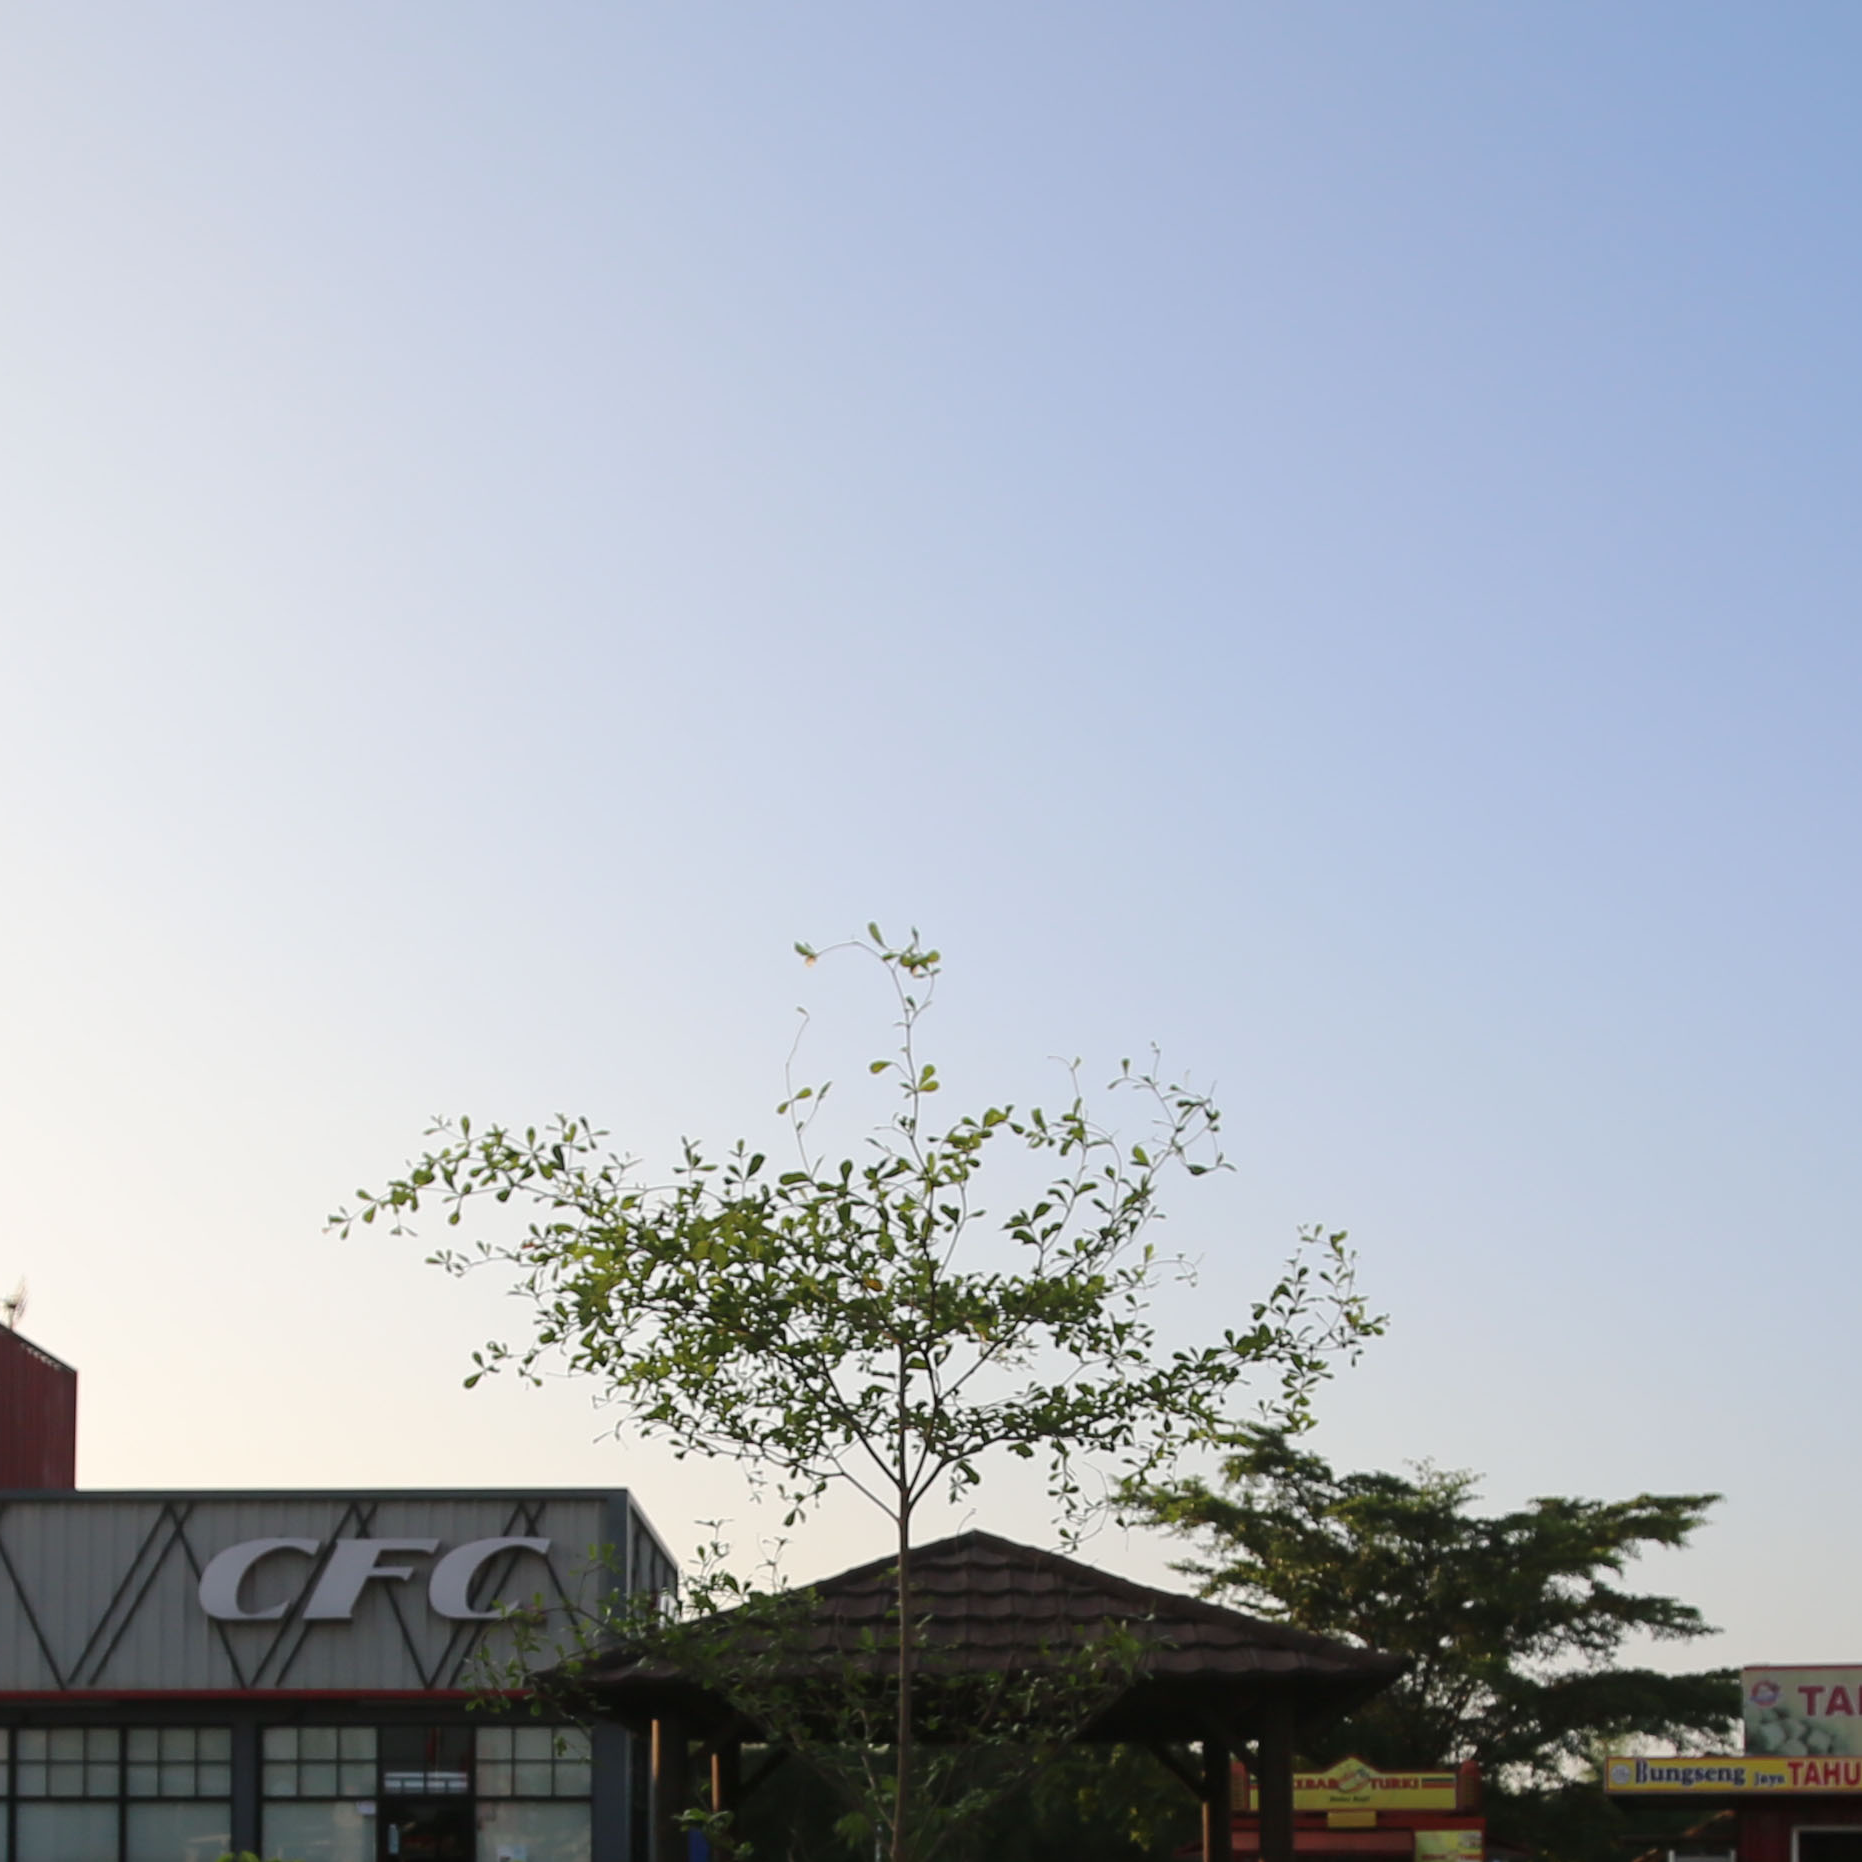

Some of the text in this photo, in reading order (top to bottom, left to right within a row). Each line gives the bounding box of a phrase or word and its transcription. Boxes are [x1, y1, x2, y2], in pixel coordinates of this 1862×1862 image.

[198, 1536, 553, 1622] CFC
[1370, 1777, 1419, 1790] TURKI
[1636, 1759, 1746, 1785] Bungseng
[1787, 1760, 1862, 1787] TAHU
